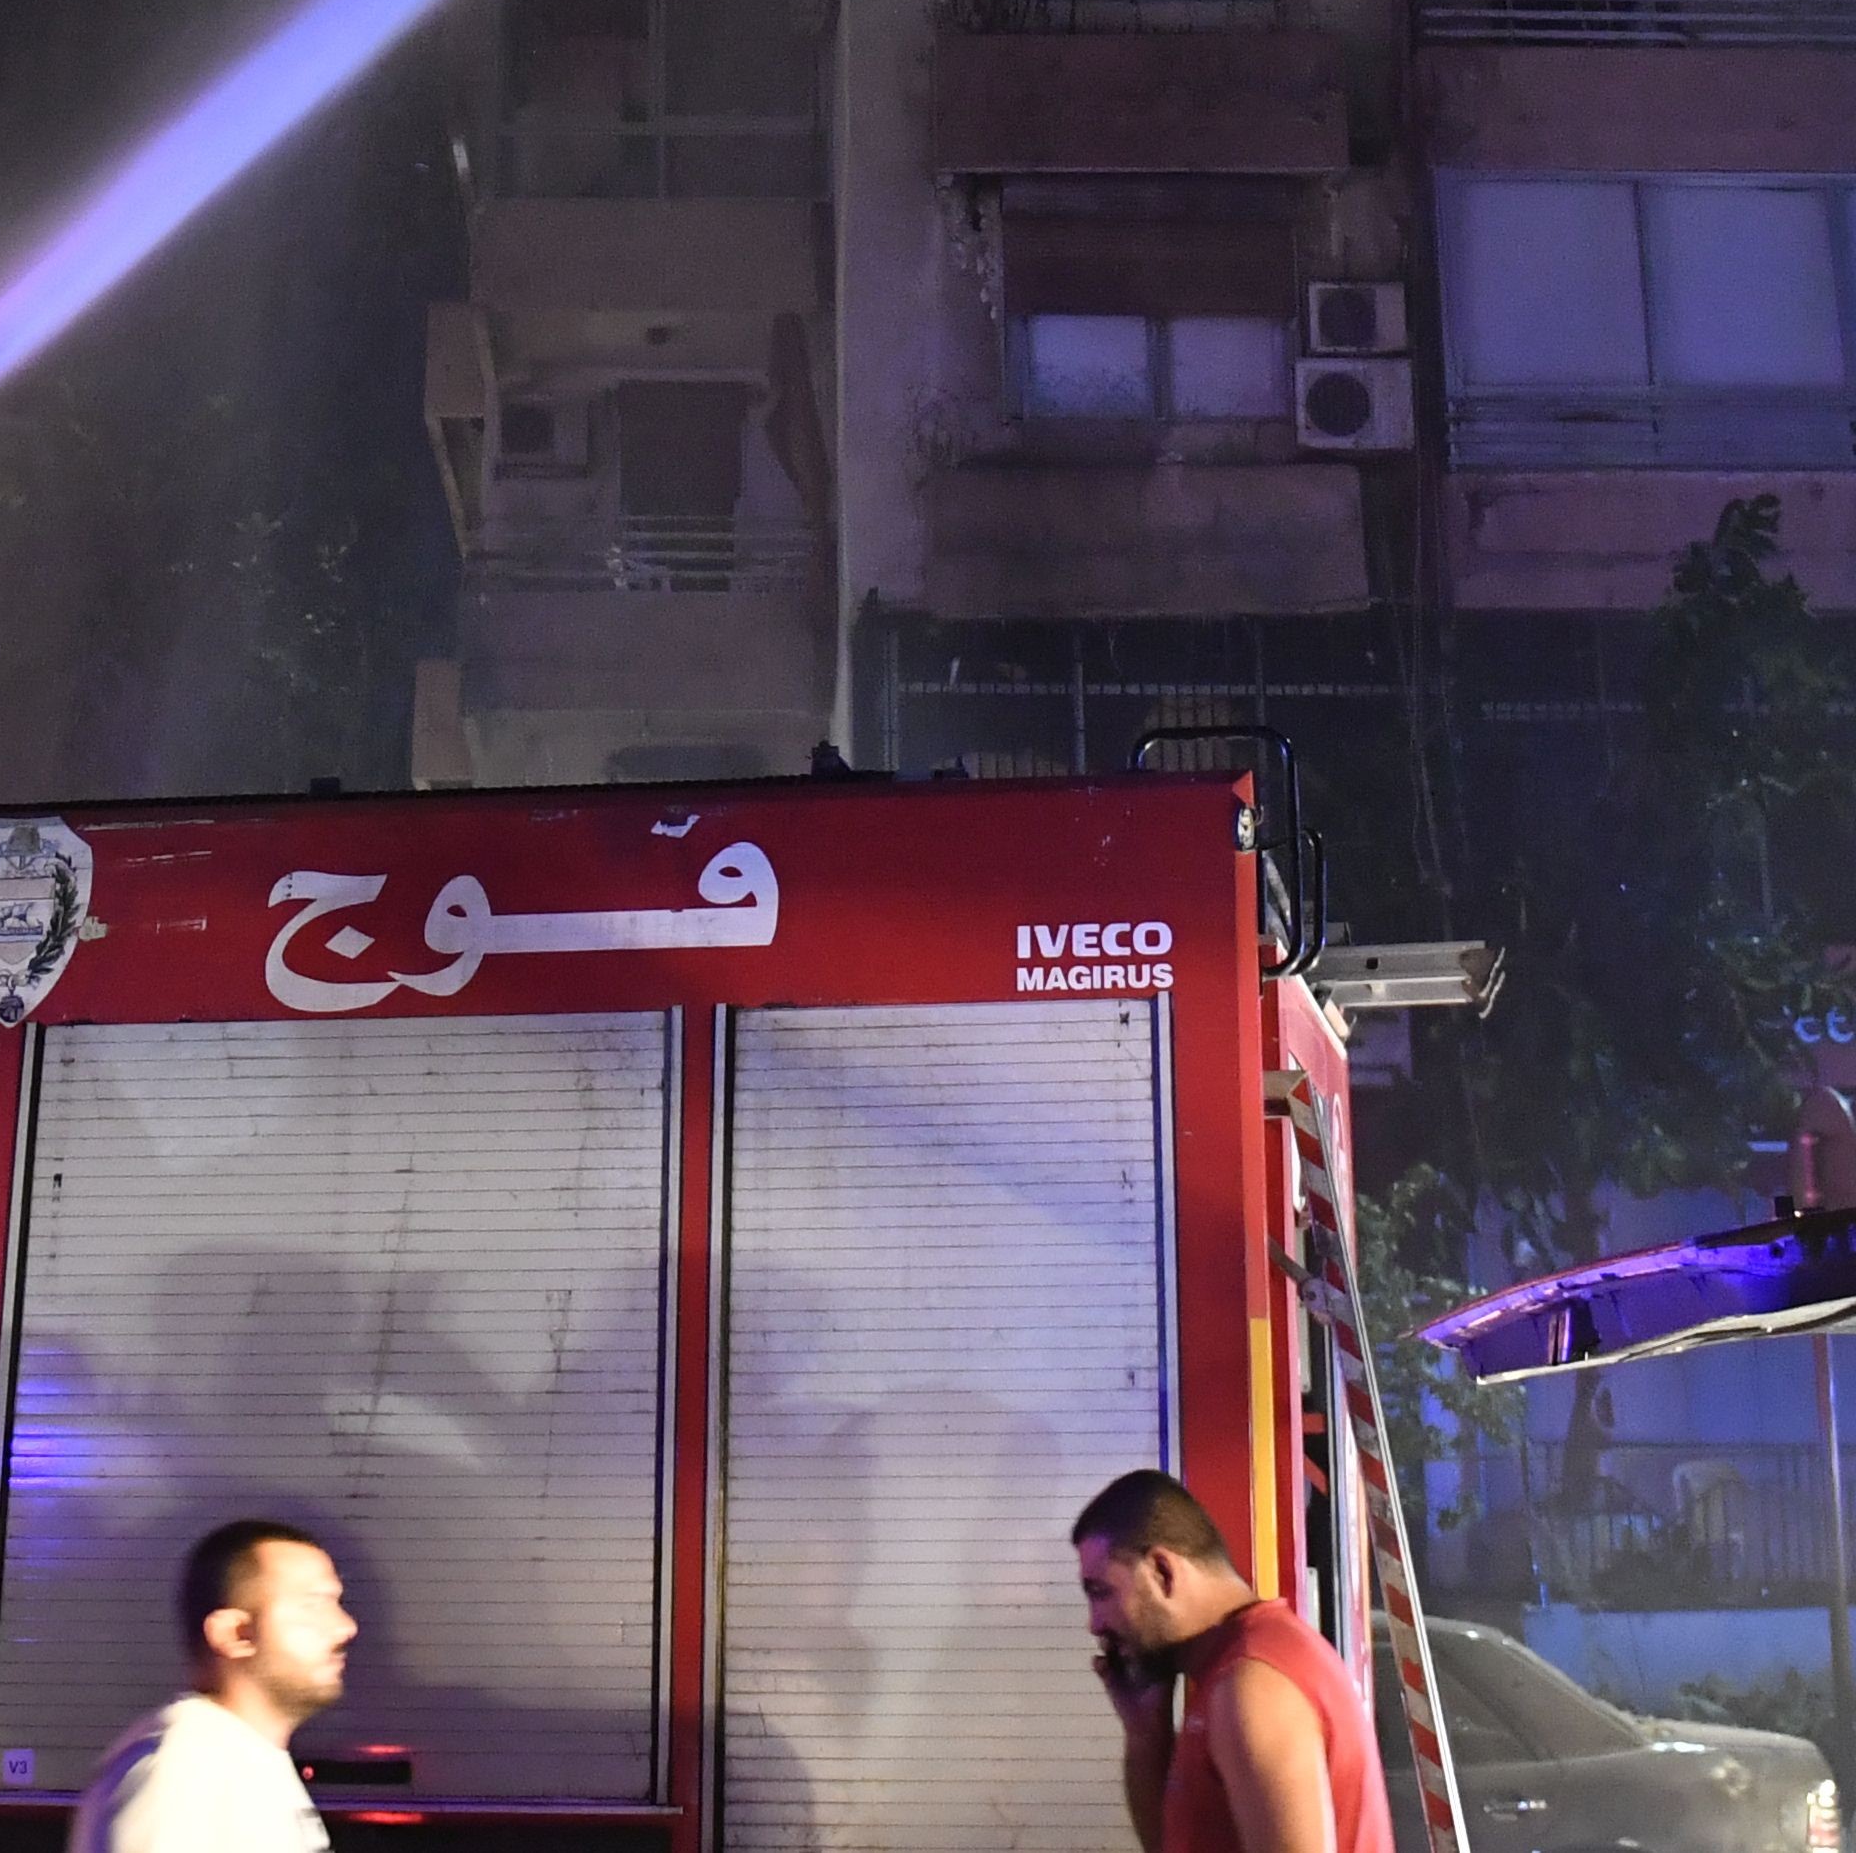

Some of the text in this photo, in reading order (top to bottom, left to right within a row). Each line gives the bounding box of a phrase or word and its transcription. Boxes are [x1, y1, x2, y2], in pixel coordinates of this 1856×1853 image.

[263, 811, 781, 1014] فوج
[1015, 920, 1175, 959] IVECO
[1014, 962, 1176, 993] MAGIRUS
[8, 1759, 28, 1775] V3
